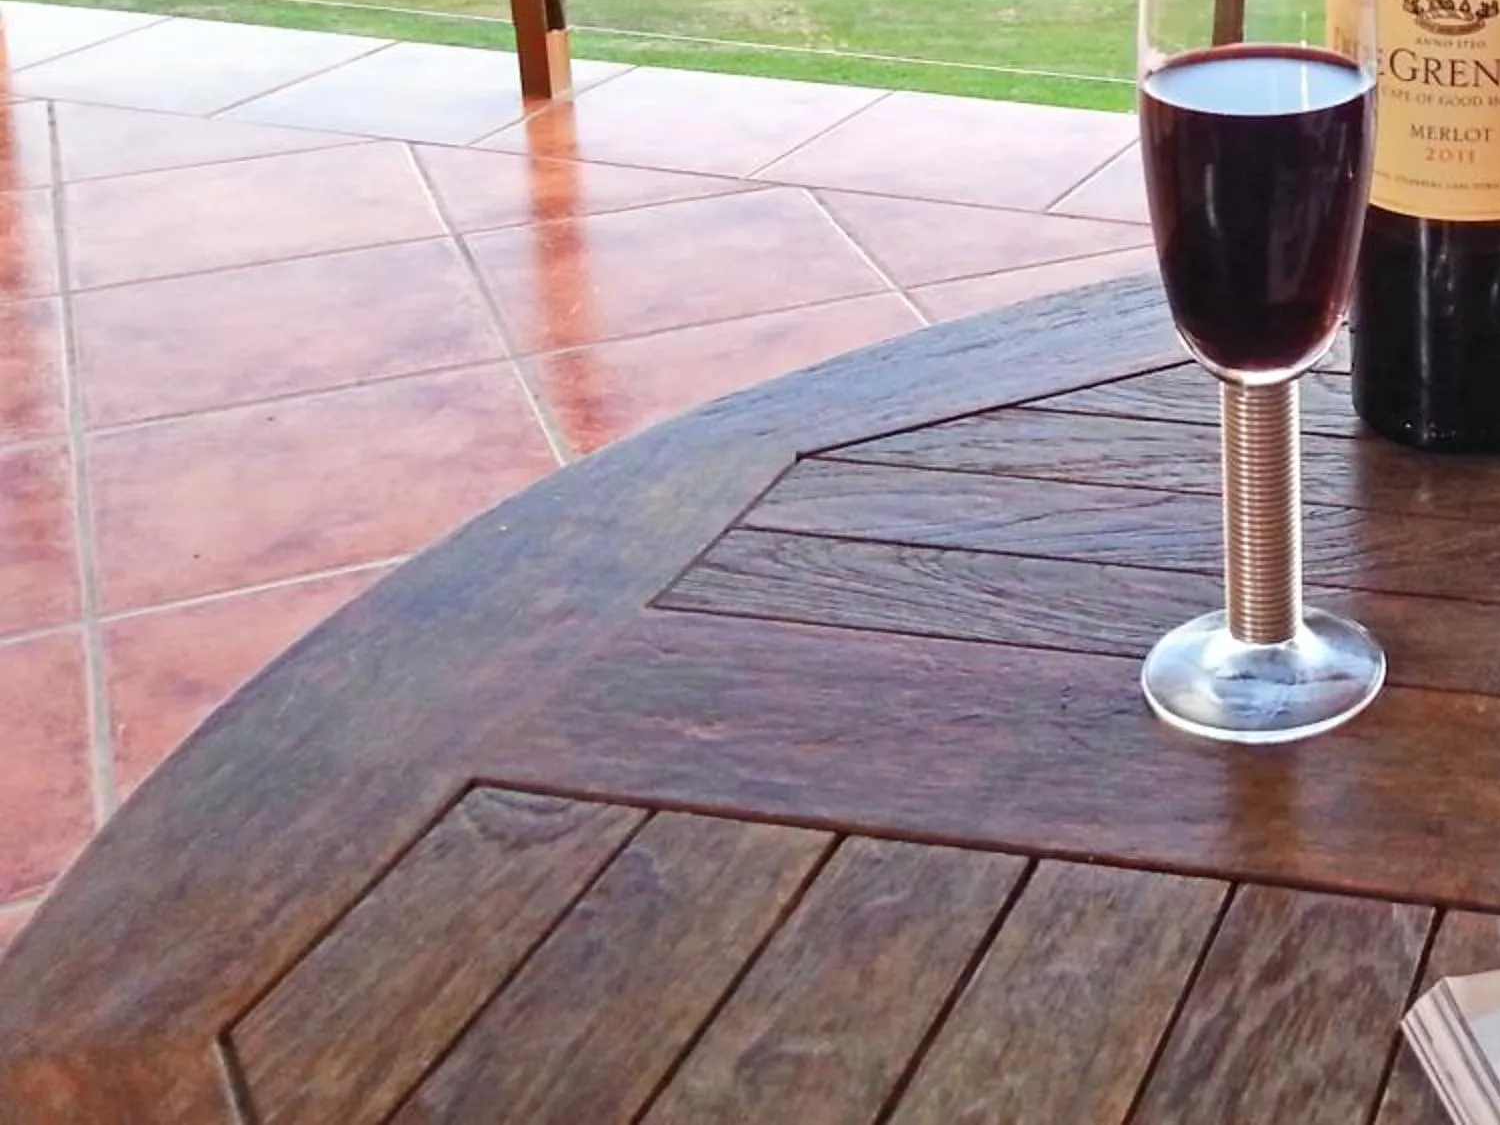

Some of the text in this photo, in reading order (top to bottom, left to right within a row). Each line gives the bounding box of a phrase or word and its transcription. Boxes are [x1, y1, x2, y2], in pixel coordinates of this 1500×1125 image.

[1415, 37, 1453, 49] ANNO
[1416, 92, 1433, 105] OF
[1438, 93, 1484, 108] GOOD
[1409, 123, 1495, 143] MERLOT
[1424, 147, 1477, 164] 2011
